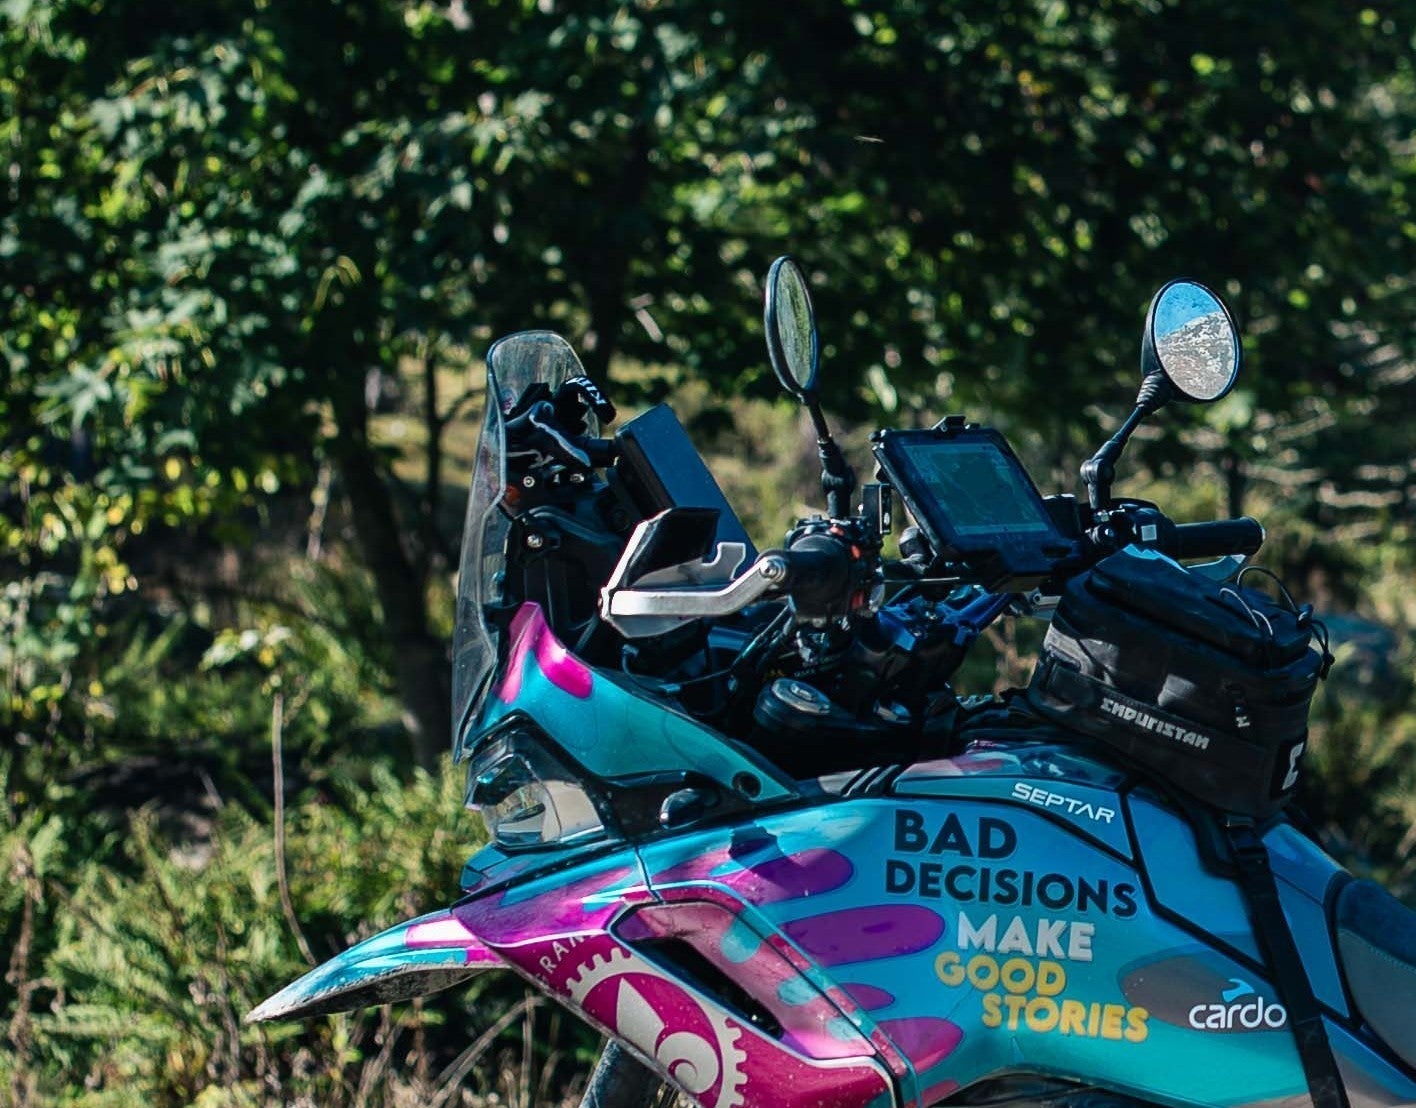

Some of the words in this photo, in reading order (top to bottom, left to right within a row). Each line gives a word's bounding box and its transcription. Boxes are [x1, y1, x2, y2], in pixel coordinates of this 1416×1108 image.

[1011, 781, 1116, 824] SEPTAR
[893, 808, 1018, 860] BAD
[885, 859, 1138, 918] DECISIONS
[957, 911, 1096, 961] MAKE
[934, 951, 1067, 997] GOOD
[981, 994, 1150, 1043] STORIES
[1188, 996, 1288, 1030] cardo
